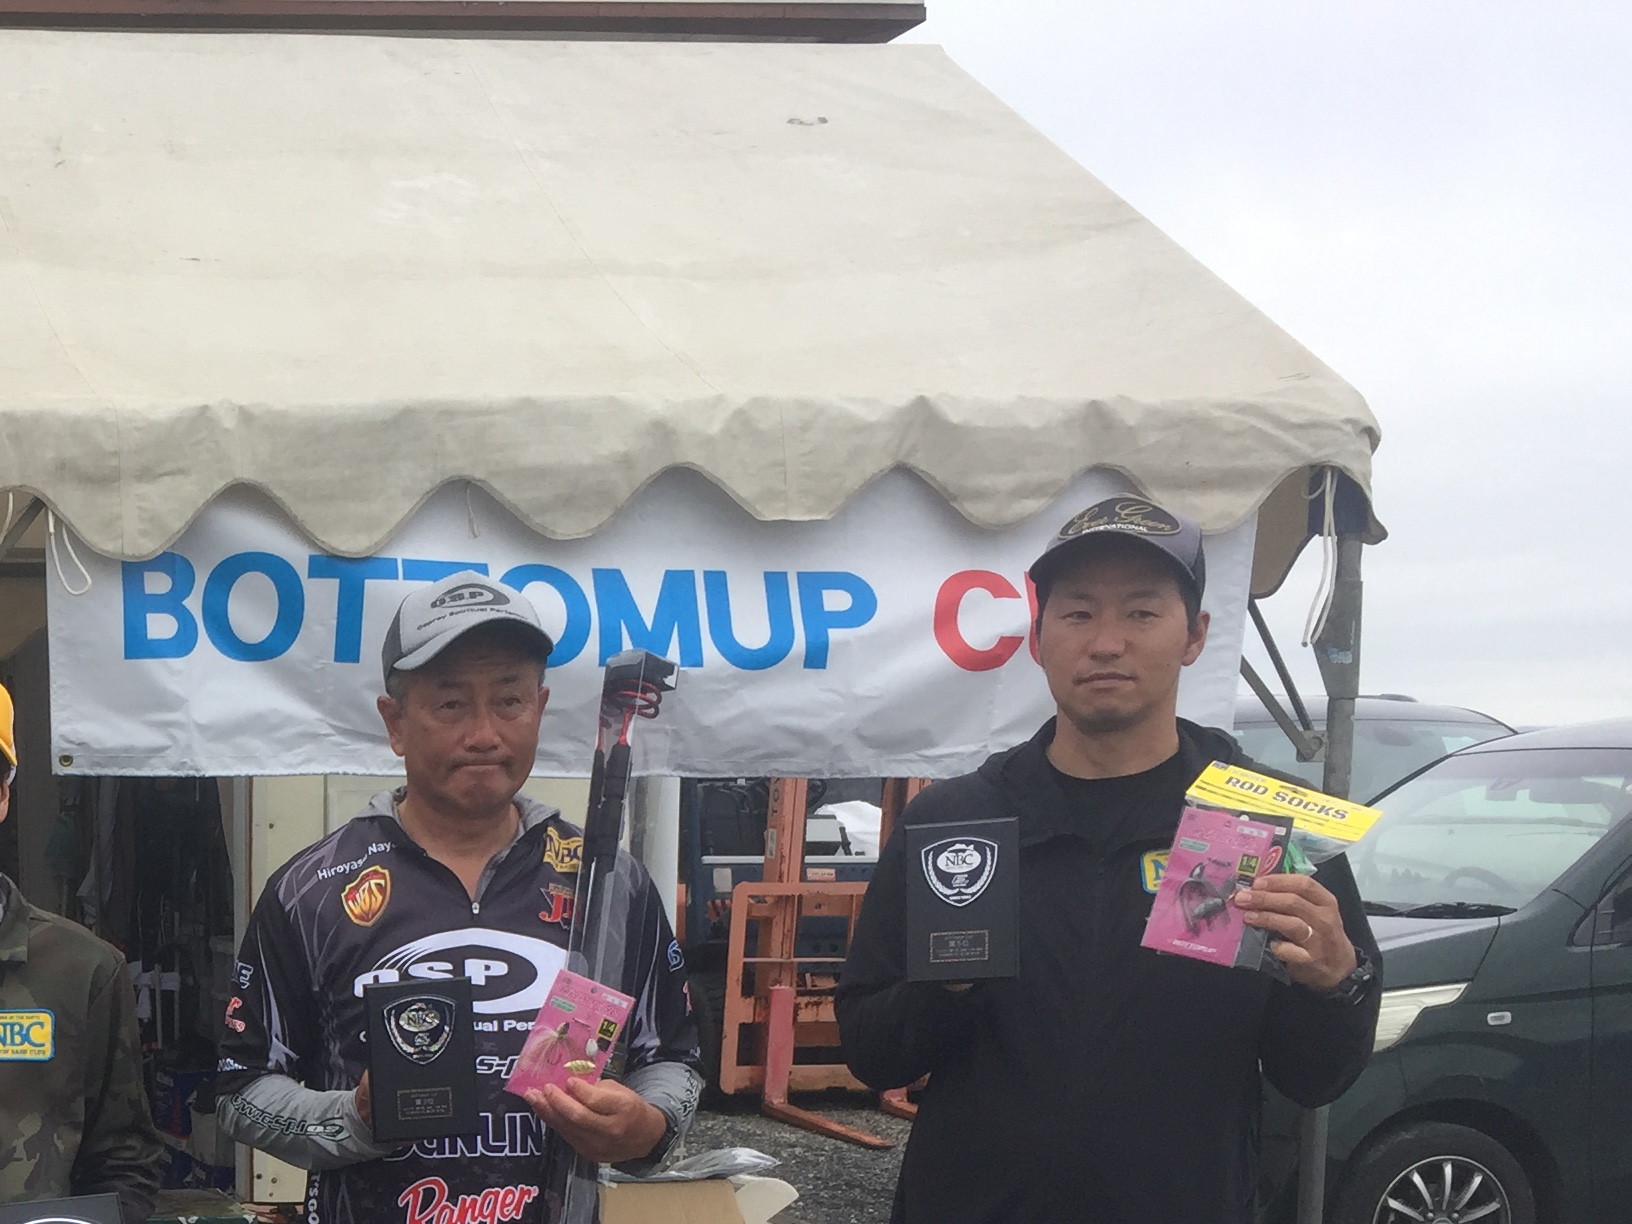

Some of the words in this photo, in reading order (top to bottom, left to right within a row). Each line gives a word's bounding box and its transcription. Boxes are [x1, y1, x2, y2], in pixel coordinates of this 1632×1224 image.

[933, 569, 1045, 672] C
[1225, 775, 1270, 797] ROD
[1272, 789, 1350, 821] SOCKS
[945, 853, 974, 867] NBC
[1241, 855, 1261, 870] 1/4
[601, 1020, 617, 1034] 1/4
